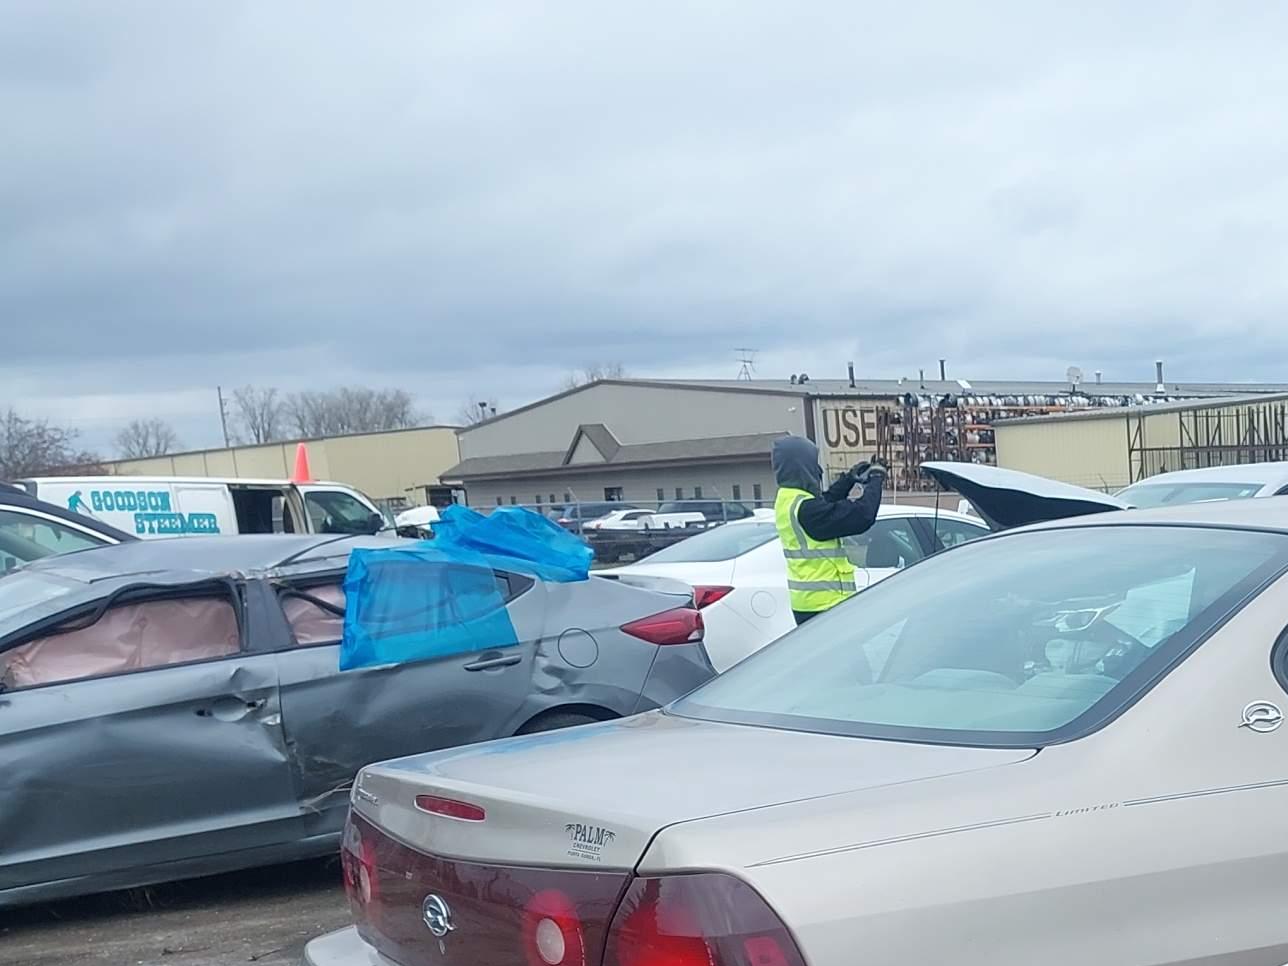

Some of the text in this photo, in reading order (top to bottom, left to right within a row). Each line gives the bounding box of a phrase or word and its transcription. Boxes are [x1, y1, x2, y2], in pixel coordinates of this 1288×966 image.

[823, 408, 882, 448] USE
[91, 491, 171, 511] GOODSON
[135, 513, 220, 533] STEEMER
[574, 823, 605, 845] PALM
